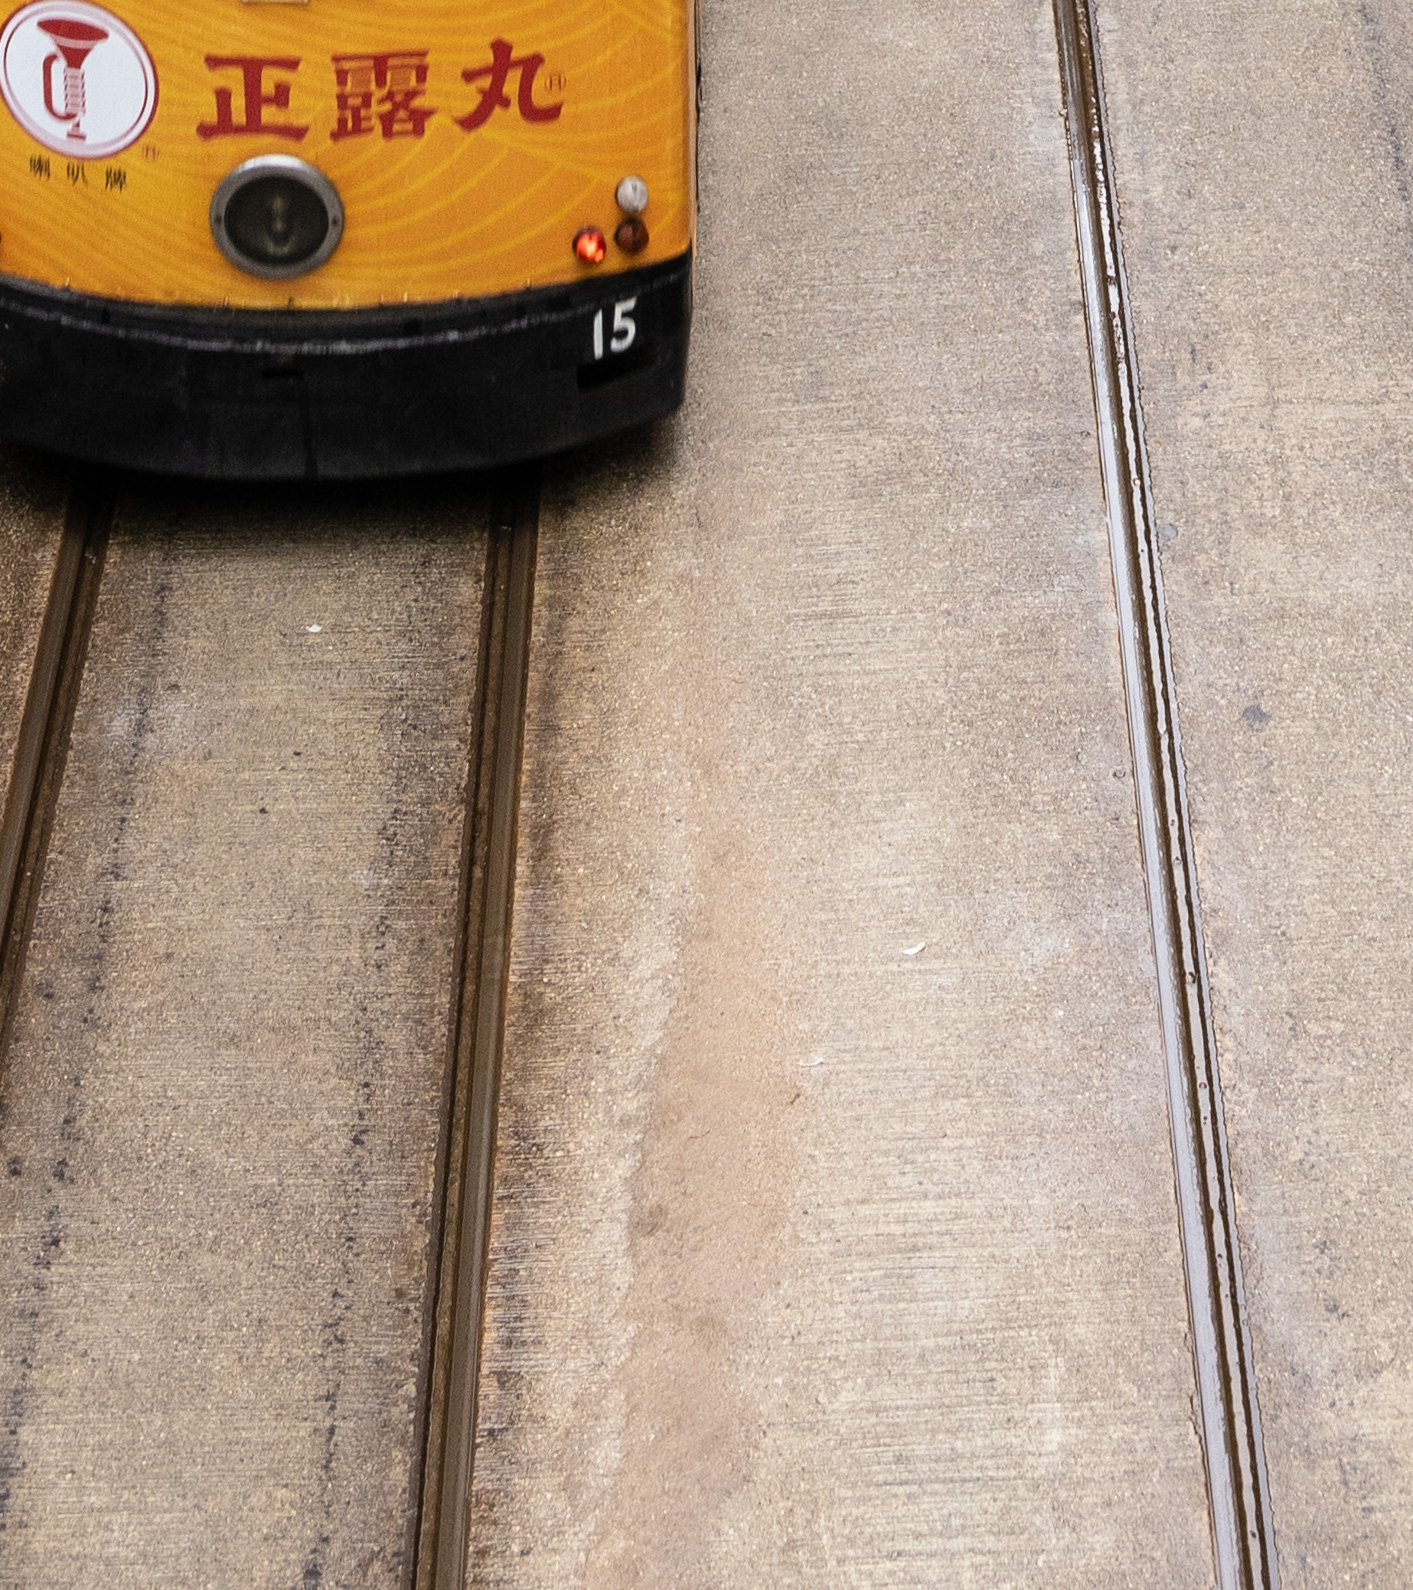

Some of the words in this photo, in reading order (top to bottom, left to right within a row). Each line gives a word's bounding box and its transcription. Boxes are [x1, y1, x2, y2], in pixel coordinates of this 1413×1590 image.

[196, 37, 564, 143] 正露丸
[29, 153, 128, 194] 喇叭牌
[593, 296, 637, 361] 15
